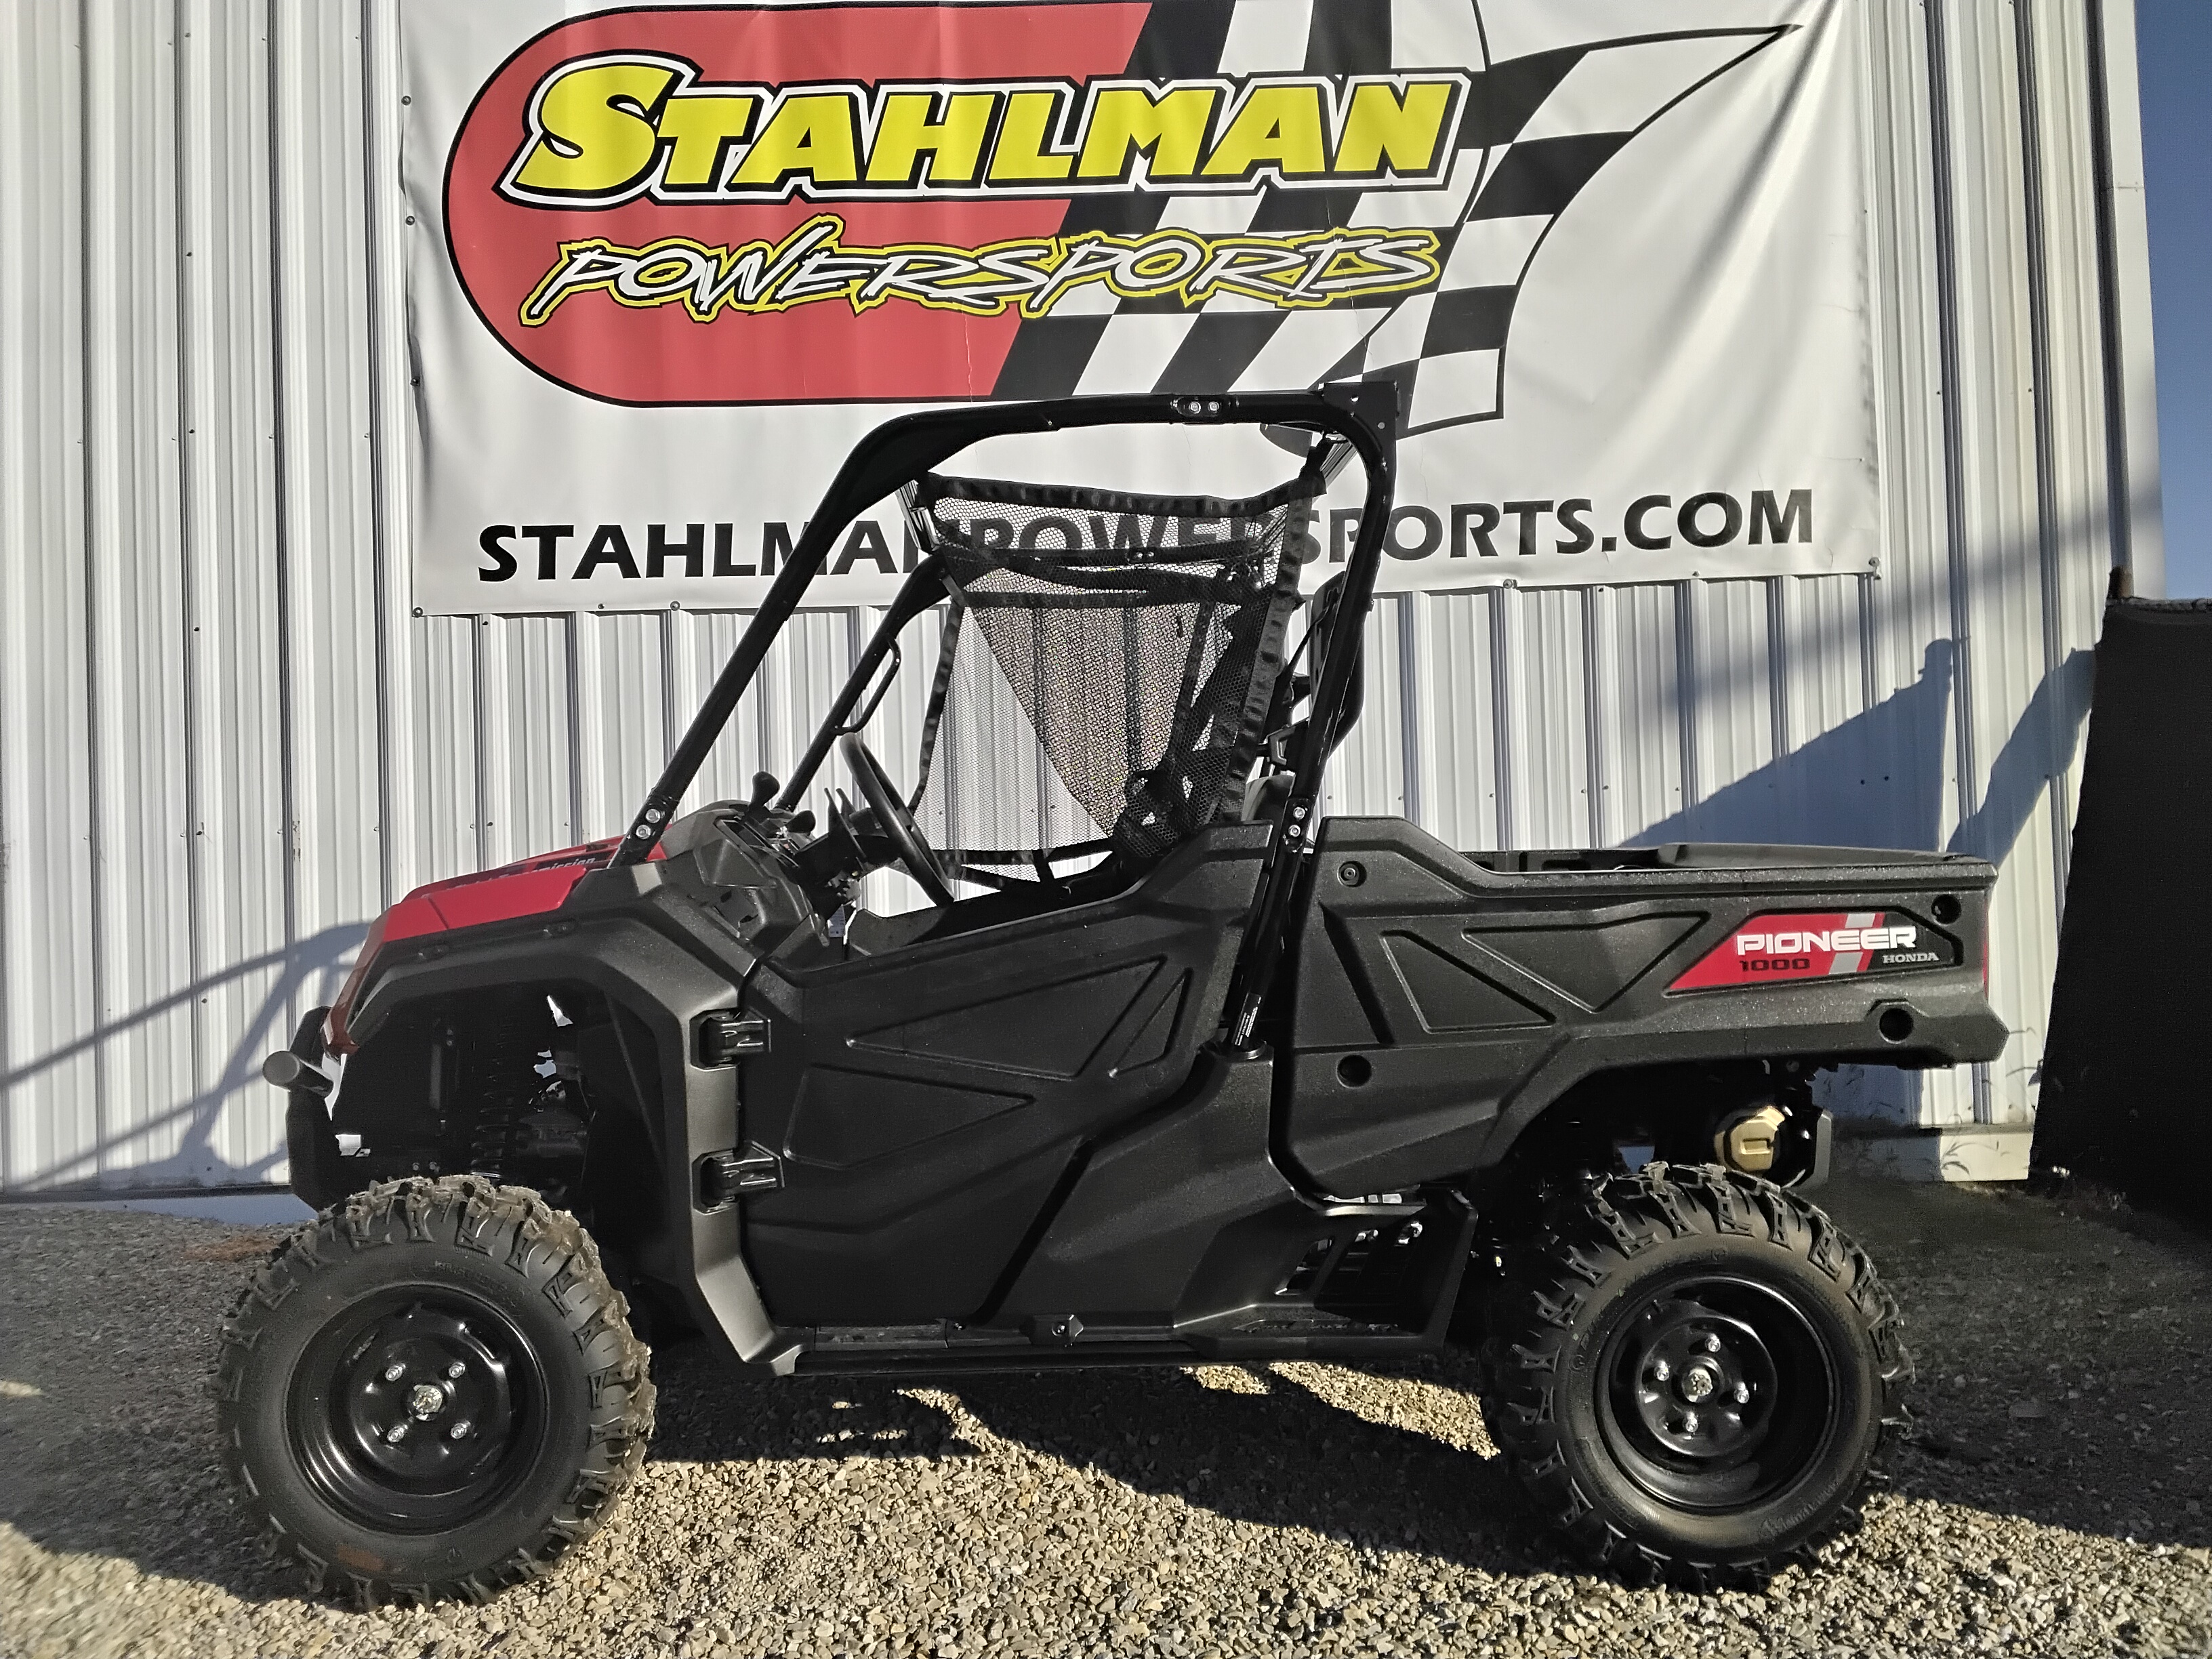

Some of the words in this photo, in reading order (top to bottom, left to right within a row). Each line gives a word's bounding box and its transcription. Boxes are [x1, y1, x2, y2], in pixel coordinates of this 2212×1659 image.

[510, 62, 1456, 192] STAHLMAN
[526, 220, 1434, 319] POWERSPORTS
[1736, 925, 1917, 956] PIONEER
[1739, 958, 1810, 972] 1000
[1882, 951, 1940, 964] HONDA
